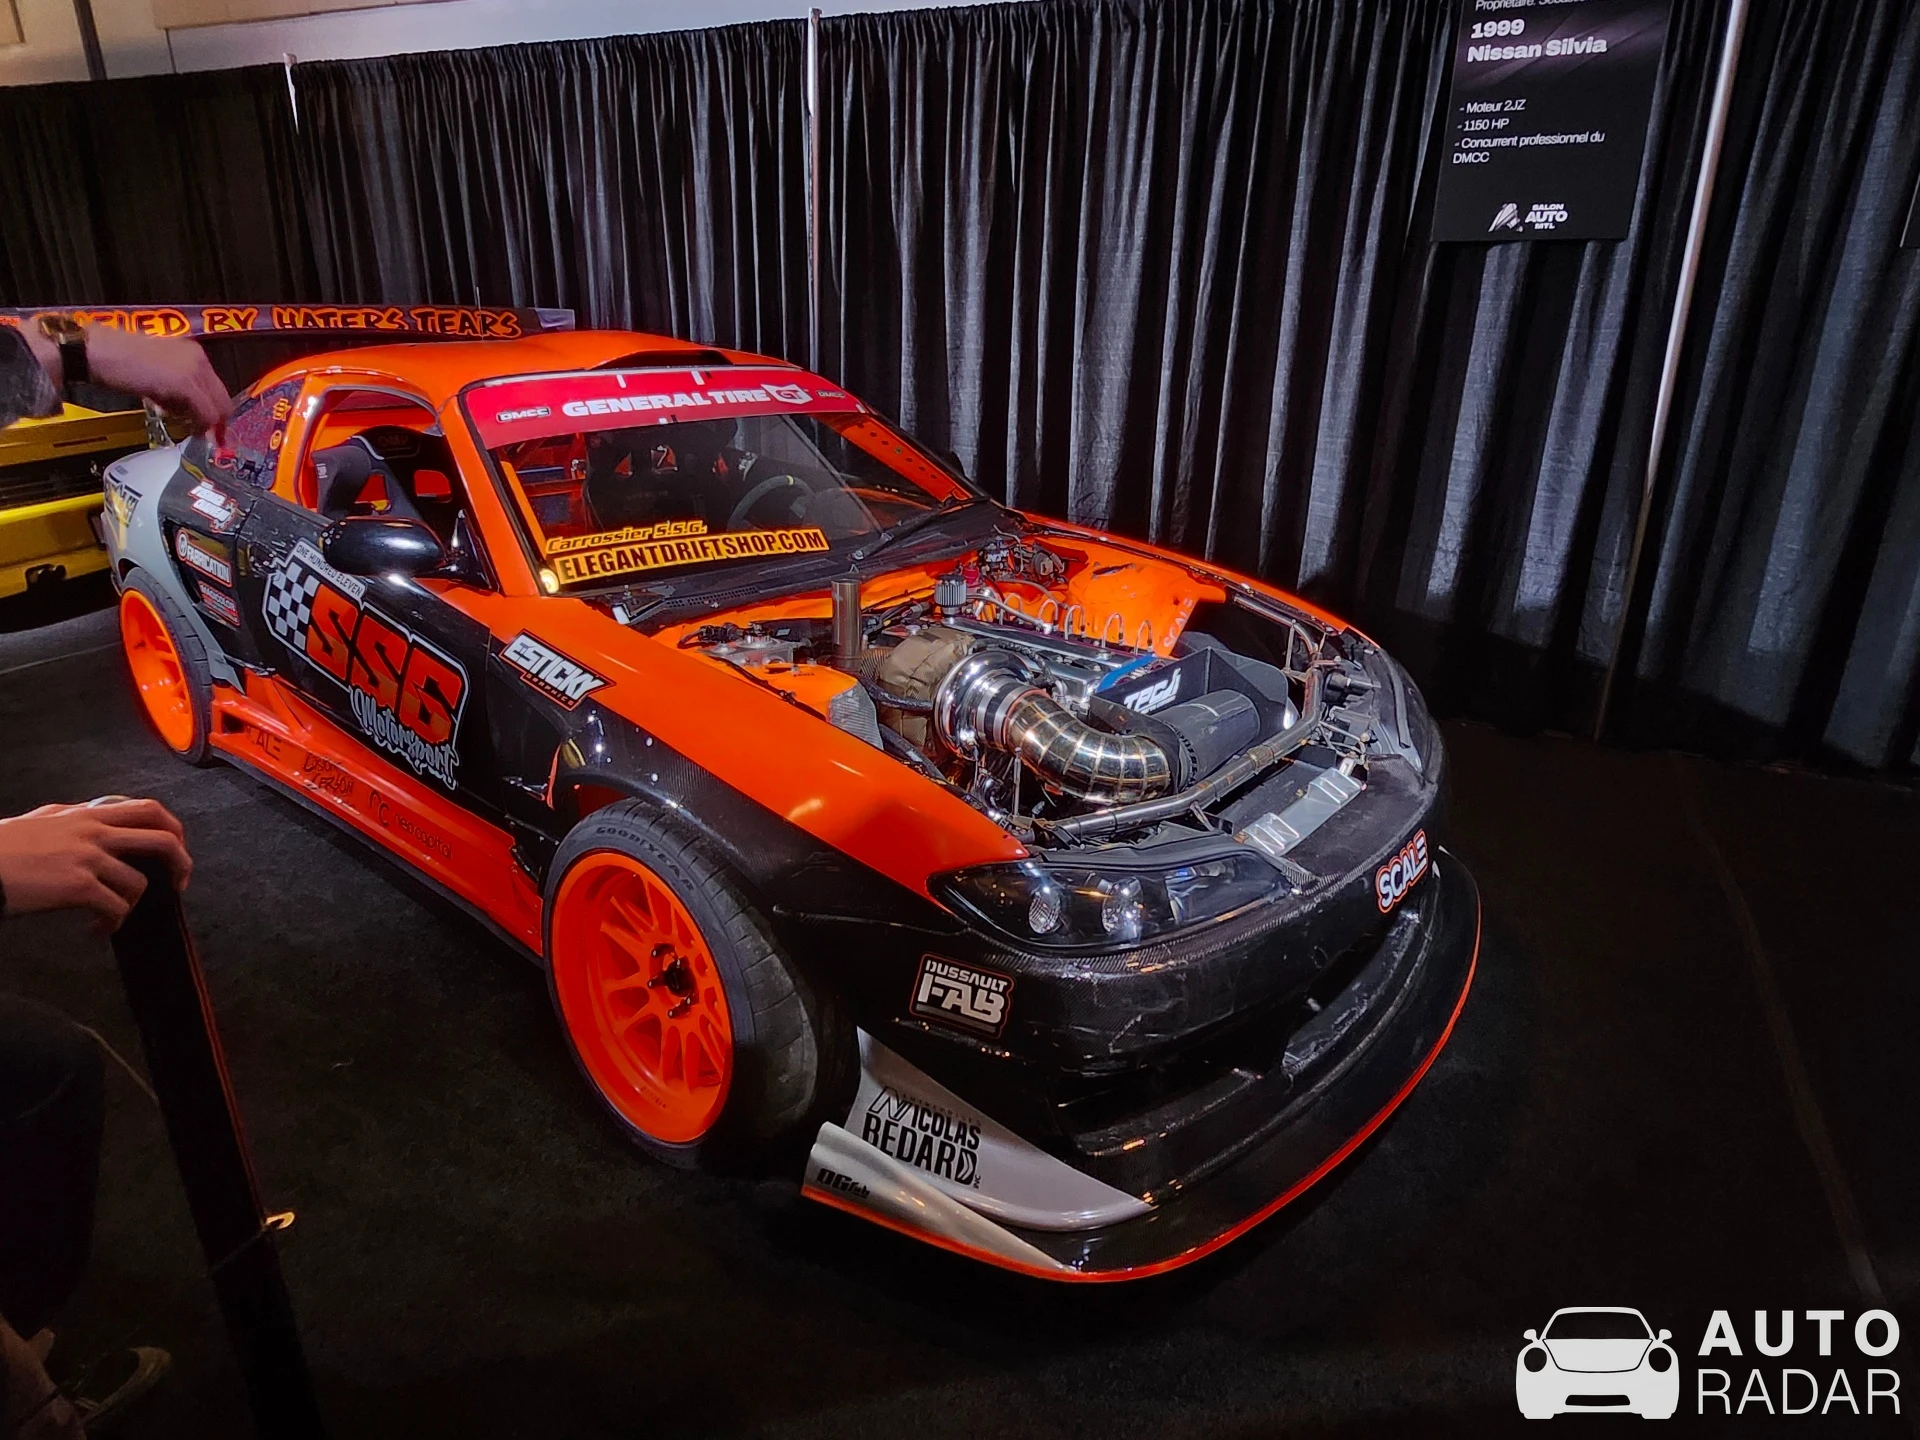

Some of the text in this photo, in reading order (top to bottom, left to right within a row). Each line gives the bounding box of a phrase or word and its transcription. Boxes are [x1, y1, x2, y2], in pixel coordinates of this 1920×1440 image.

[1471, 19, 1525, 39] 1999
[1467, 36, 1607, 62] Nissan Silvia
[1466, 102, 1502, 113] Moteur
[1504, 99, 1526, 111] 2JZ
[1461, 137, 1518, 148] Concurrent
[1519, 131, 1589, 147] professionnel
[1590, 131, 1605, 143] du
[1463, 119, 1489, 131] 1150
[1491, 118, 1509, 130] HP
[1453, 152, 1490, 164] DMCC
[1525, 210, 1568, 223] AUTO
[1532, 203, 1564, 211] SALON
[1534, 222, 1555, 230] MTL
[202, 308, 258, 333] BY
[410, 307, 523, 339] TEARS
[498, 406, 551, 422] DMCC
[562, 390, 710, 417] GENERAL
[701, 389, 771, 405] TIRE
[548, 520, 707, 552] Carrossier S.S.G.
[187, 543, 231, 584] FABRICATION
[296, 544, 364, 598] ONE HUNDRED ELEVEN
[559, 530, 827, 581] ELEGANTDRIFTSHOP.COM
[306, 583, 463, 745] SSG
[526, 674, 575, 706] GRAPHICS
[352, 687, 460, 786] Motorsport
[596, 826, 695, 891] GOODYEAR
[1379, 836, 1427, 908] SCALE
[925, 960, 1008, 992] DUSSAULT
[917, 972, 1005, 1024] FAB
[869, 1086, 982, 1150] NICOLAS
[862, 1112, 979, 1186] BEDARD
